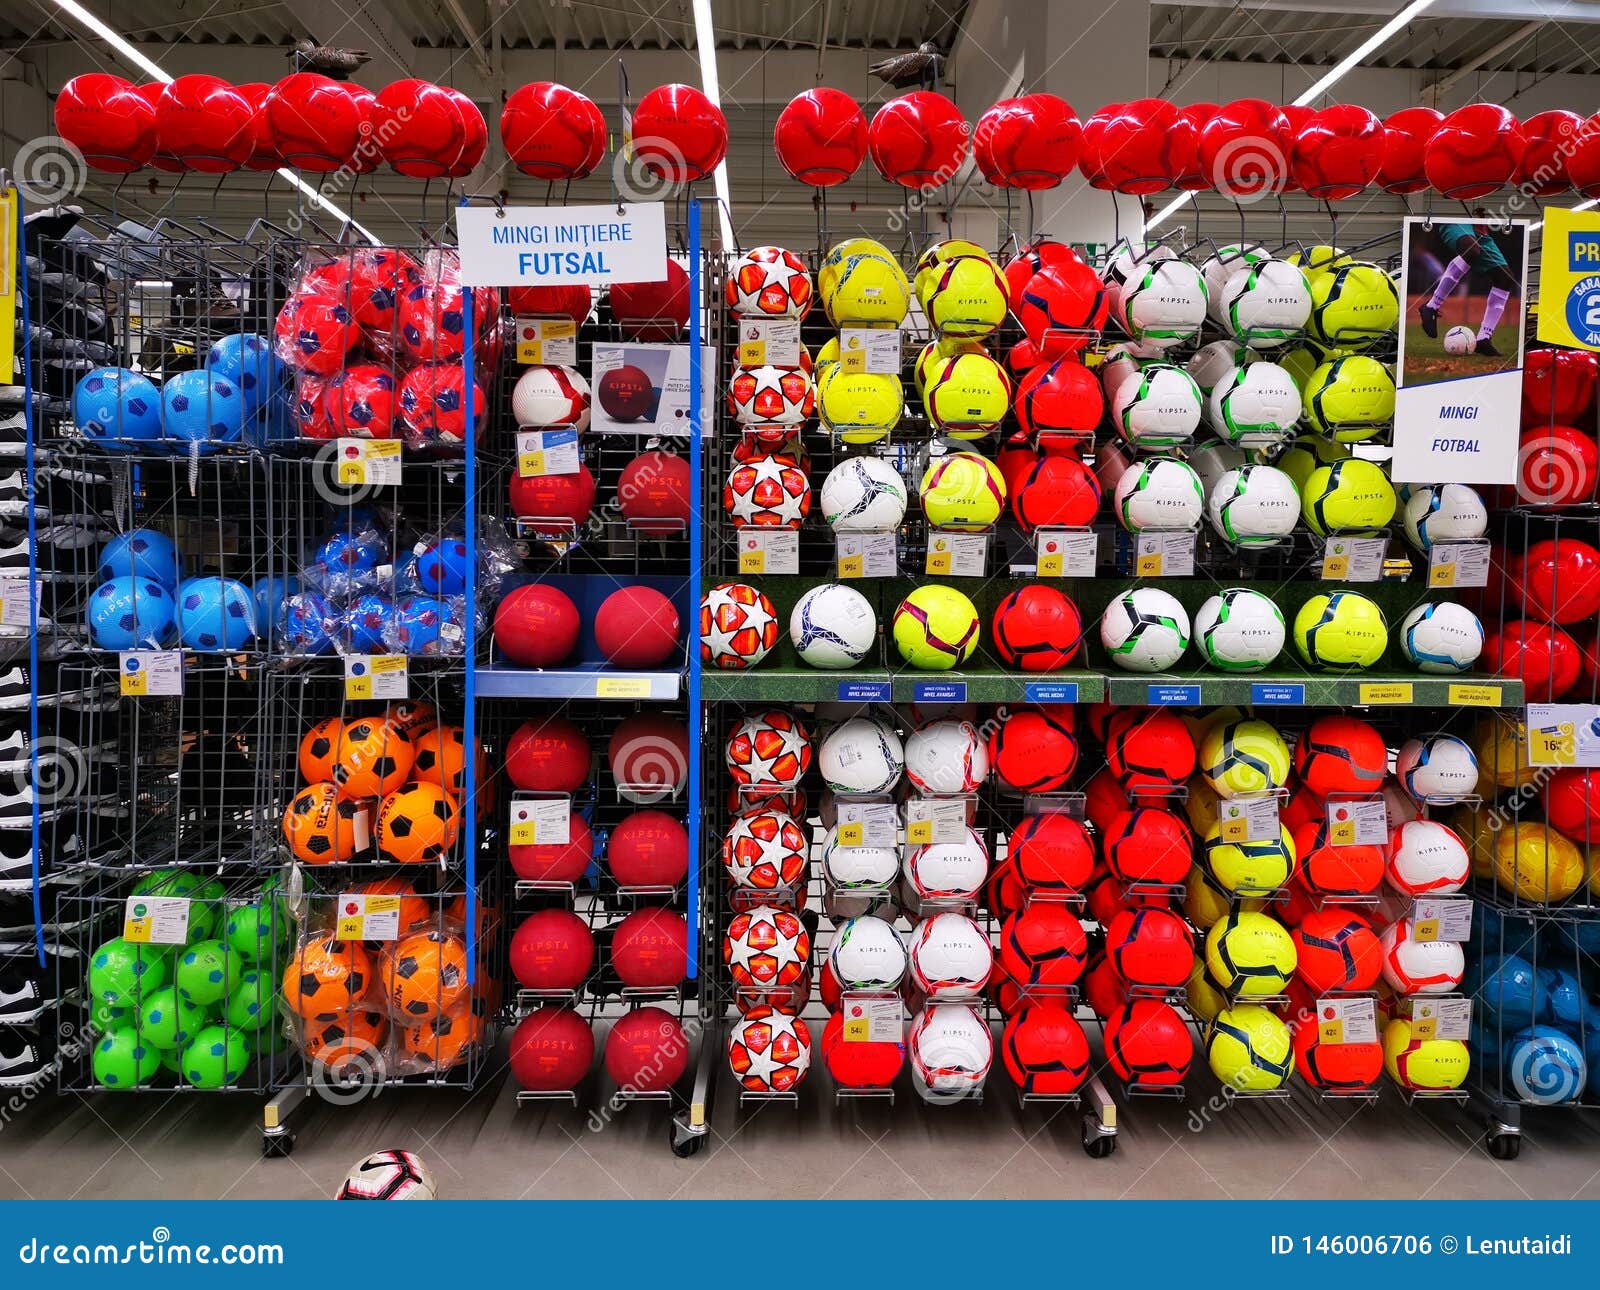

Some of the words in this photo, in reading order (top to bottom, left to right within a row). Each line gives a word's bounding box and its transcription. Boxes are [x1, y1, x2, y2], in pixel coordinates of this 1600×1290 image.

[494, 226, 549, 244] MINGI
[519, 252, 611, 275] FUTSAL
[609, 381, 643, 392] KIPSTA
[962, 387, 990, 395] KIPSTA
[1439, 406, 1479, 420] MINGI
[1432, 439, 1481, 453] FOTBAL
[521, 477, 572, 489] KIPSTA
[947, 497, 977, 505] KIPSTA
[1156, 499, 1186, 507] KIPSTA
[512, 600, 562, 618] KIPSTA
[1346, 630, 1376, 638] KIPSTA
[1440, 626, 1468, 637] KIPSTA
[519, 739, 568, 750] KIPSTA
[317, 788, 338, 829] KIPSTA
[376, 796, 396, 845] KIPSTA
[623, 830, 670, 841] KIPSTA
[1418, 845, 1448, 855] KIPSTA
[1255, 930, 1283, 938] KIPSTA
[625, 935, 674, 946] KIPSTA
[521, 940, 569, 953] KIPSTA
[526, 1040, 576, 1051] KIPSTA
